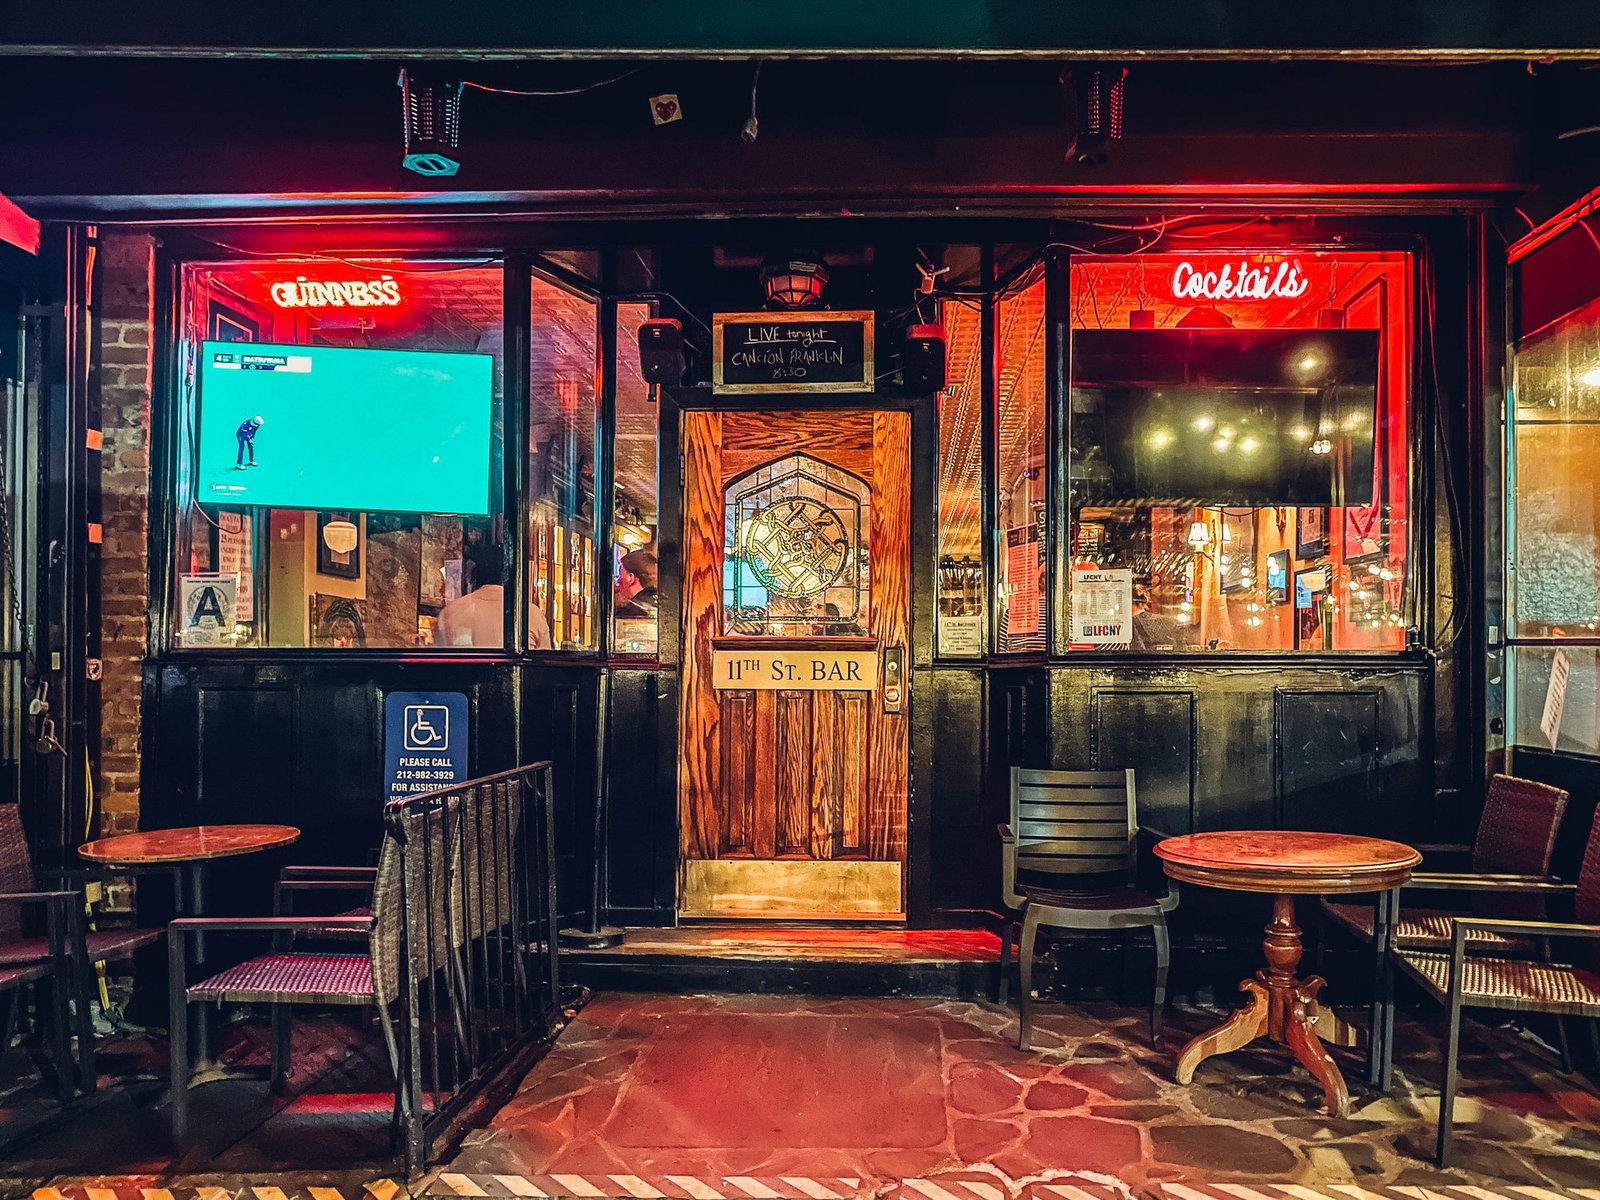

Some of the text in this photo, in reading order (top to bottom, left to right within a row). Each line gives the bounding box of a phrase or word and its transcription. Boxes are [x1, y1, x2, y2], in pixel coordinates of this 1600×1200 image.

[1173, 261, 1308, 299] Cocktails
[748, 326, 828, 347] LIVE tonight
[789, 346, 843, 366] FRANKLIN
[772, 366, 806, 379] 8:30
[189, 586, 226, 627] A
[1093, 625, 1121, 636] LFCNY
[727, 660, 760, 681] 11TH
[811, 660, 863, 681] BAR
[399, 758, 452, 766] PLEASE CALL
[396, 771, 454, 779] 212-982-3929
[391, 783, 453, 791] FOR ASSISTA
